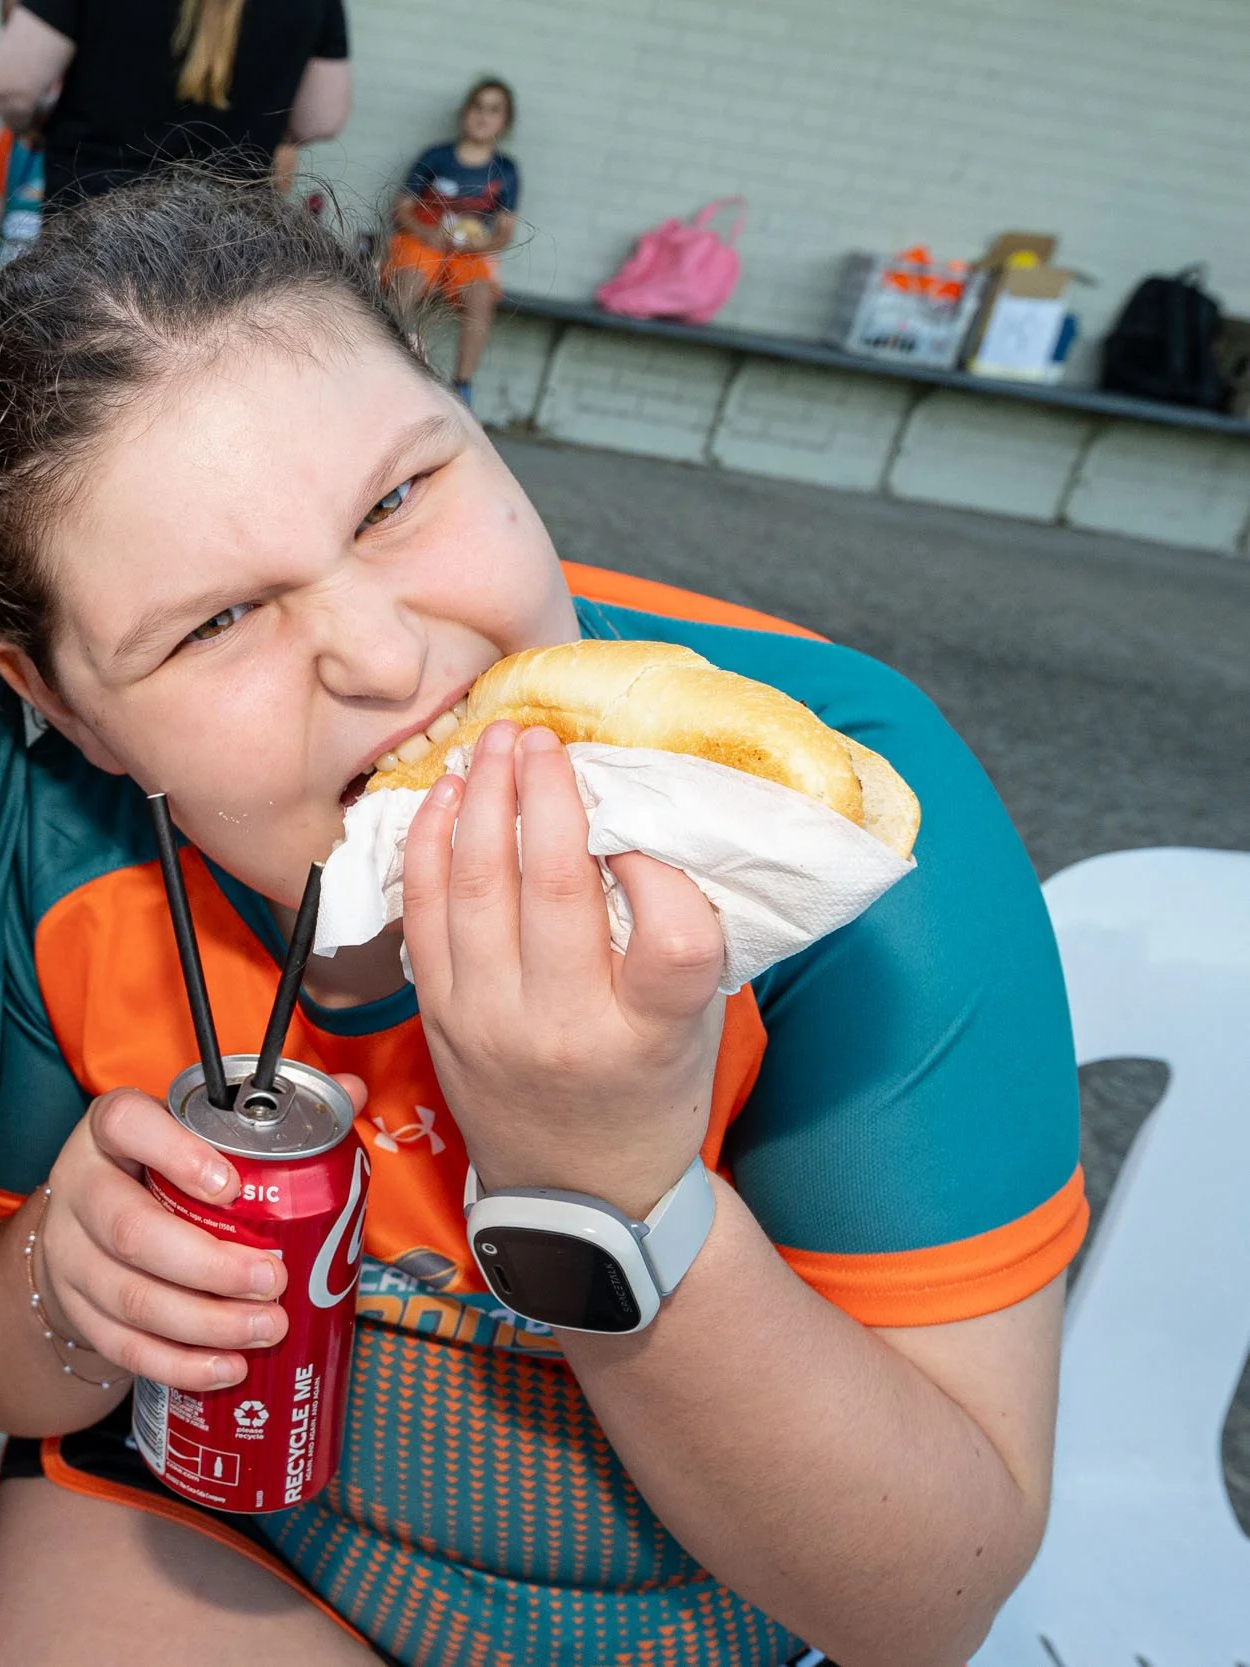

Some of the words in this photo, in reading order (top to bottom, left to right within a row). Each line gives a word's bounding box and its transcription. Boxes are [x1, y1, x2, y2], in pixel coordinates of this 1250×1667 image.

[293, 1363, 314, 1401] ME
[234, 1433, 265, 1441] recycle
[236, 1427, 264, 1435] please
[284, 1404, 310, 1505] RECYCLE
